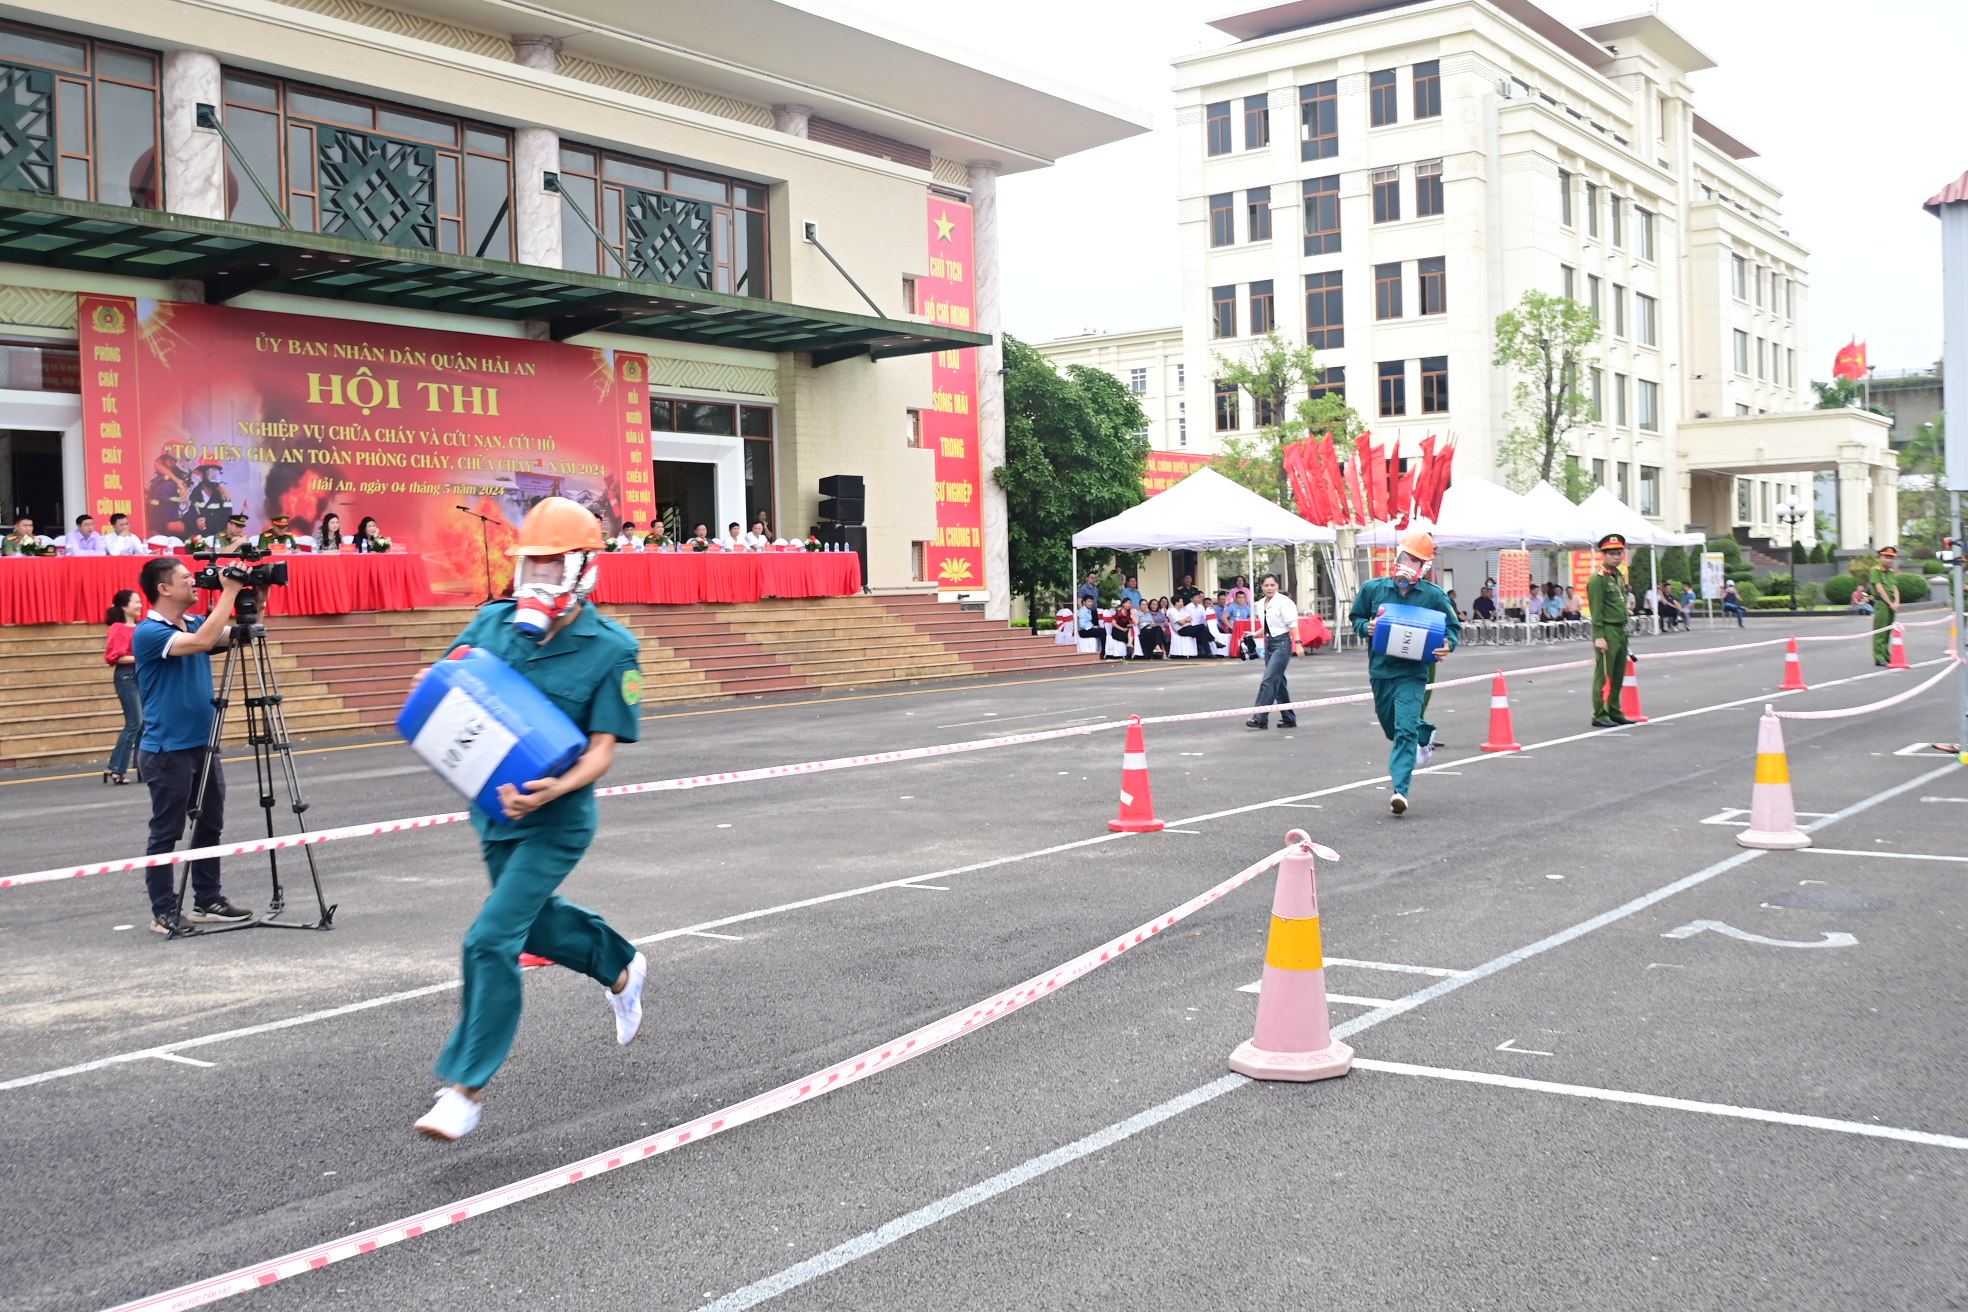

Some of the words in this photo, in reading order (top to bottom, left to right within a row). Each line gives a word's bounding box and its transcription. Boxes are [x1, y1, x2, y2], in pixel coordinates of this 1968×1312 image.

[950, 304, 970, 327] MINH
[255, 331, 282, 353] ỦY
[288, 339, 328, 357] BAN
[333, 342, 385, 362] NHÂN
[390, 346, 427, 366] DÂN
[430, 352, 477, 372] QUẬN
[482, 355, 510, 374] HẢI
[514, 362, 536, 376] AN
[306, 366, 402, 416] HỘI
[417, 382, 501, 416] THI
[237, 418, 299, 441] NGHIỆP
[303, 424, 325, 443] VỤ
[328, 423, 372, 442] CHỮA
[375, 426, 416, 444] CHÁY
[420, 428, 440, 446] VÀ
[443, 429, 471, 447] CỨU
[509, 433, 534, 450] CỨU
[537, 435, 556, 454] HỘ
[940, 436, 965, 458] TRONG
[203, 441, 242, 461] LIÊN
[247, 447, 276, 462] GIA
[280, 448, 303, 463] AN
[308, 446, 352, 465] TOÀN
[355, 448, 407, 467] PHÒNG
[457, 454, 494, 471] CHỮA
[549, 458, 577, 475] NĂM
[578, 463, 606, 476] 2024
[310, 477, 333, 491] Hải
[335, 480, 356, 493] An,
[360, 479, 388, 495] ngày
[391, 481, 406, 493] 04
[409, 481, 441, 496] tháng
[442, 483, 450, 494] 5
[453, 483, 476, 495] năm
[479, 485, 505, 496] 2024
[946, 479, 973, 507] NGHIỆP
